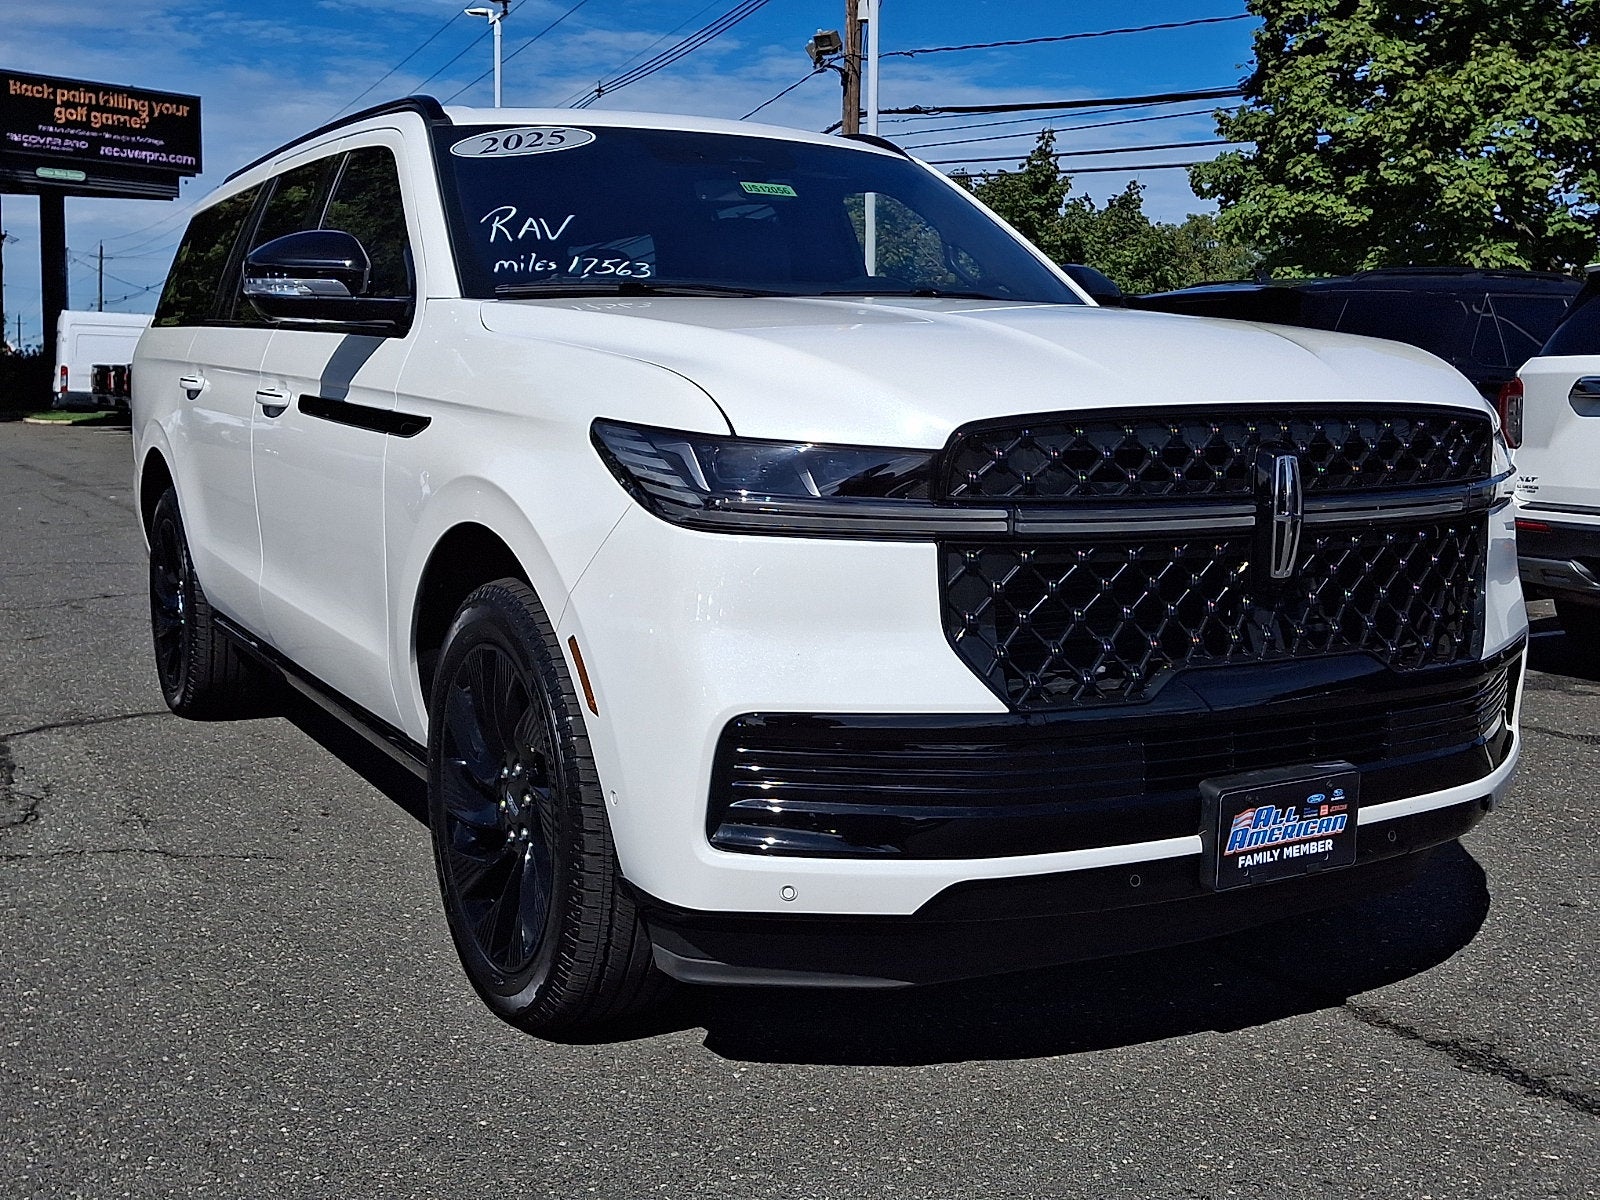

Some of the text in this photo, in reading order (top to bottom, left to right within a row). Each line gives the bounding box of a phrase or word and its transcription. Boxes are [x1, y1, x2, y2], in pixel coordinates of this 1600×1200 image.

[54, 106, 87, 124] golf
[57, 87, 96, 105] pain
[99, 91, 149, 118] killing
[151, 101, 190, 118] your
[478, 129, 567, 155] 2025
[743, 184, 791, 195] US12056
[480, 206, 576, 243] RAV
[493, 253, 557, 273] miles
[1237, 838, 1334, 868] FAMILY MEMBER
